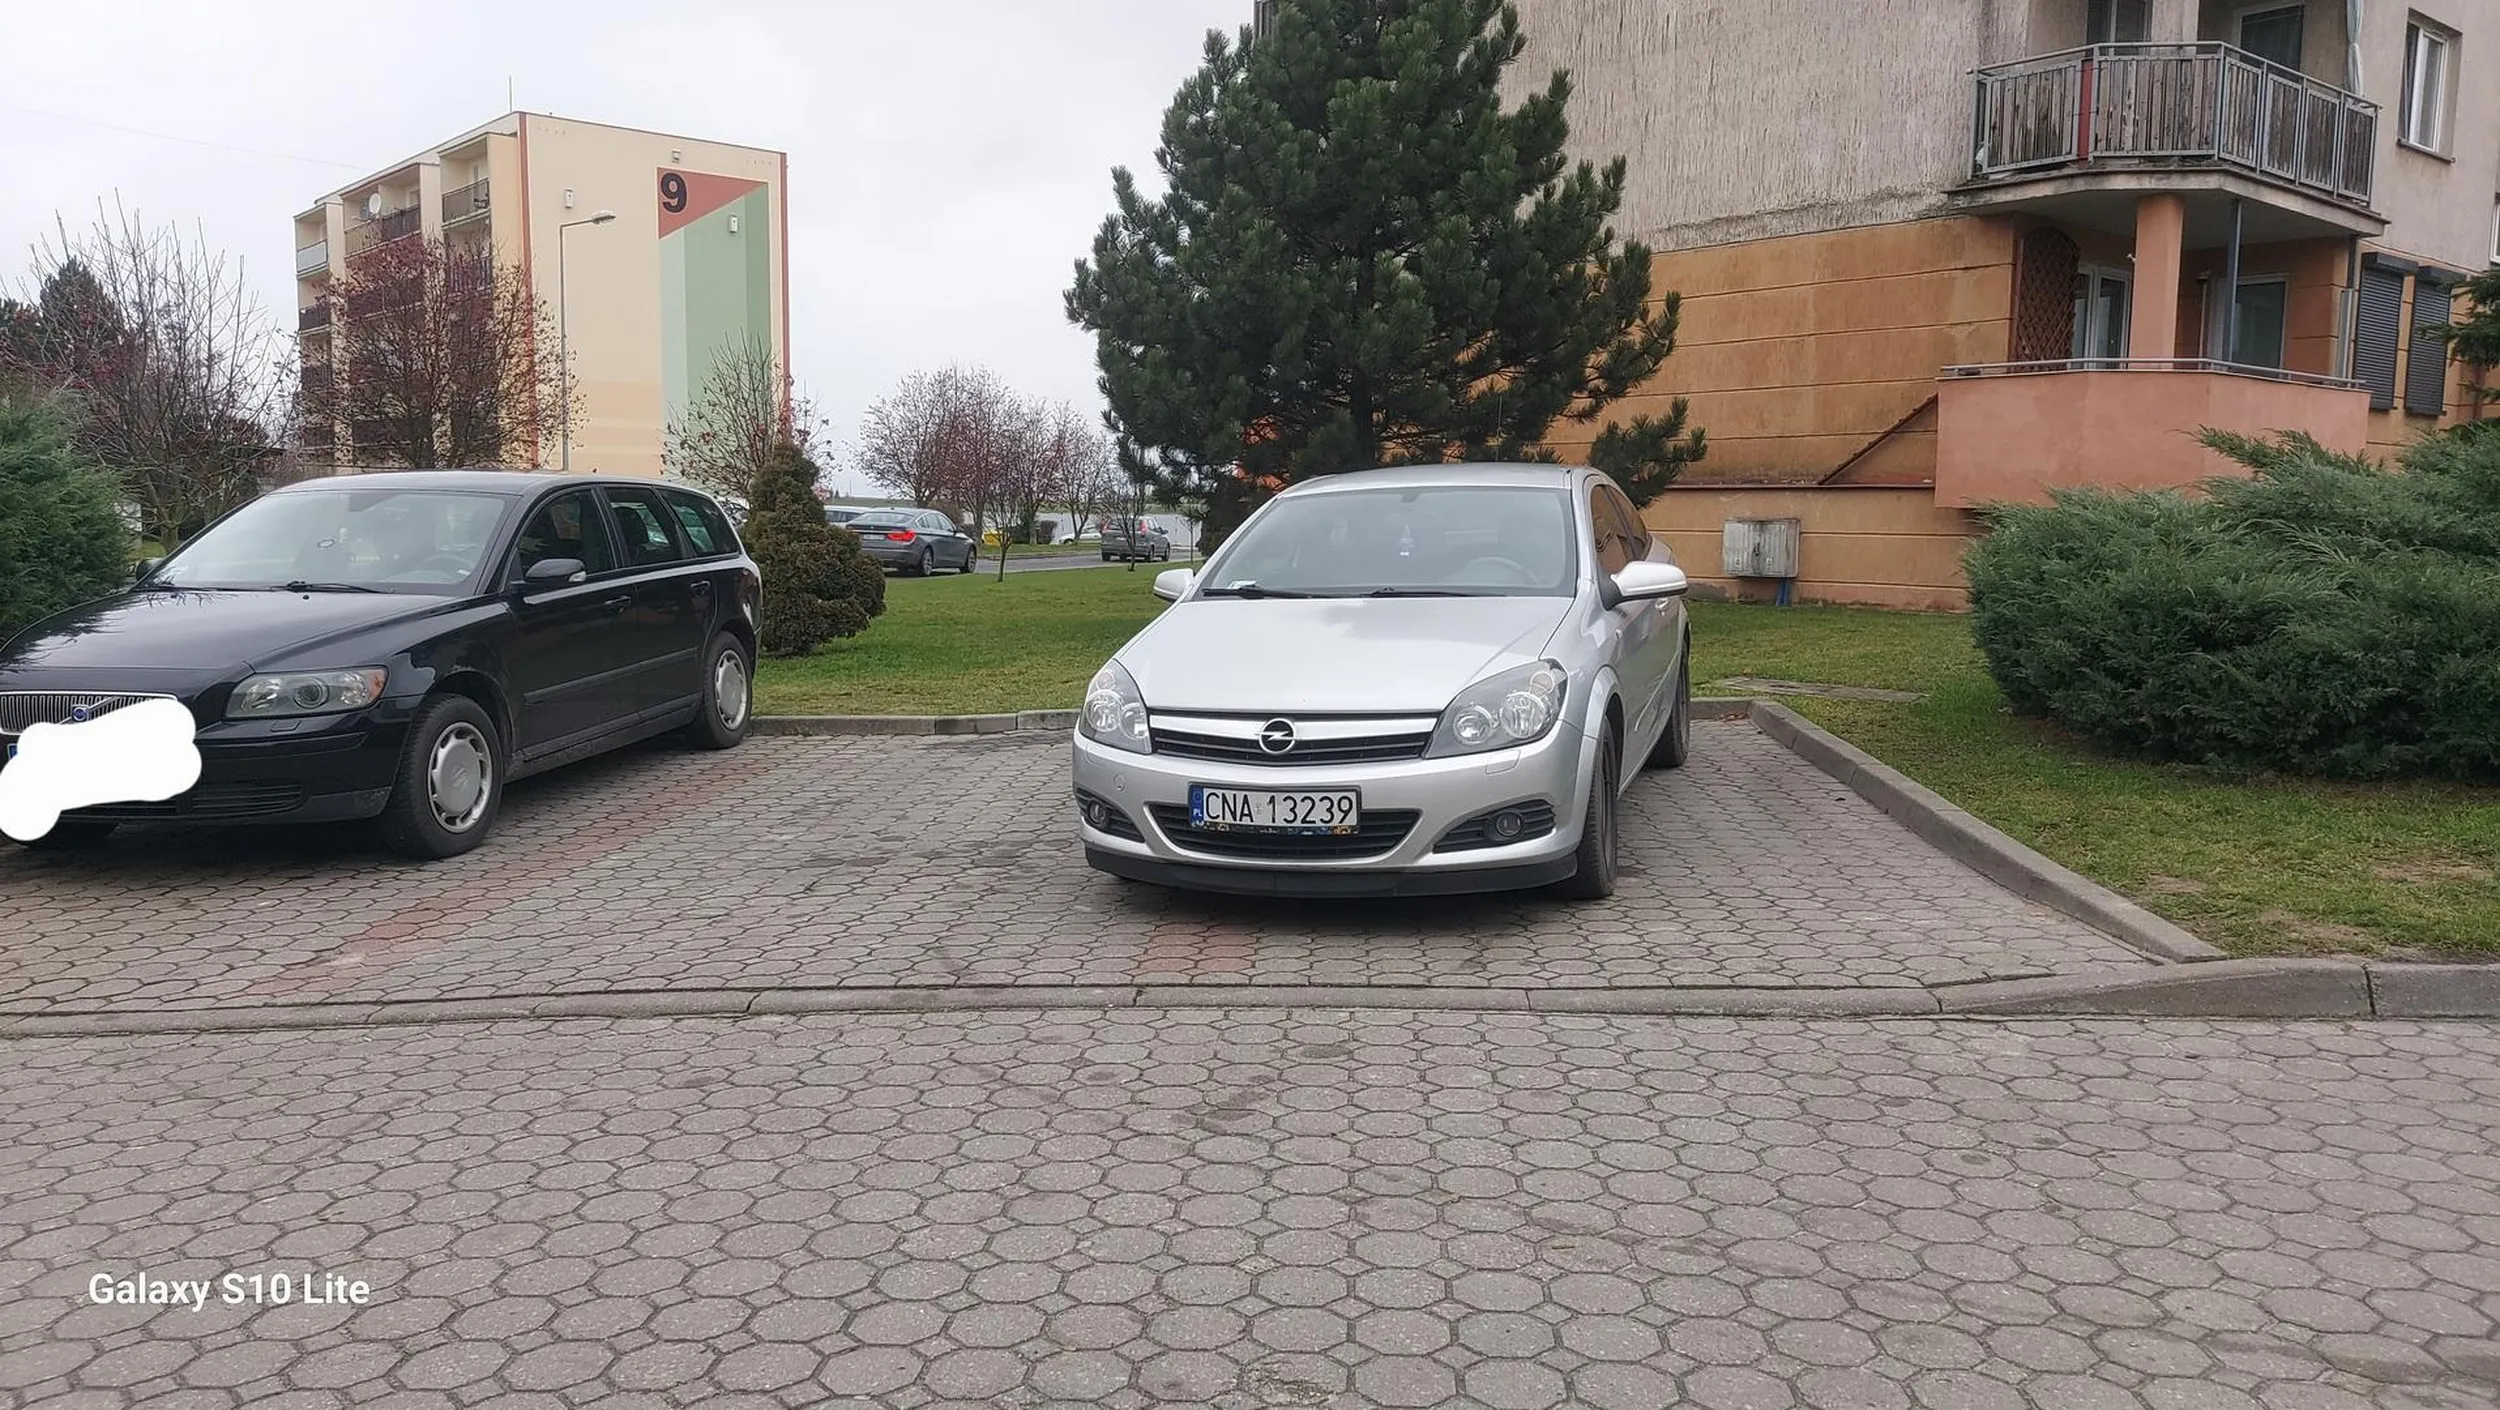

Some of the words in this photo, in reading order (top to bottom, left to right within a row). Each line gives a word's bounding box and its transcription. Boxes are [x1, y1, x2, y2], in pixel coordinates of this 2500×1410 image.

[660, 172, 687, 213] 9
[1205, 792, 1254, 823] CNA
[1266, 795, 1354, 825] 13239
